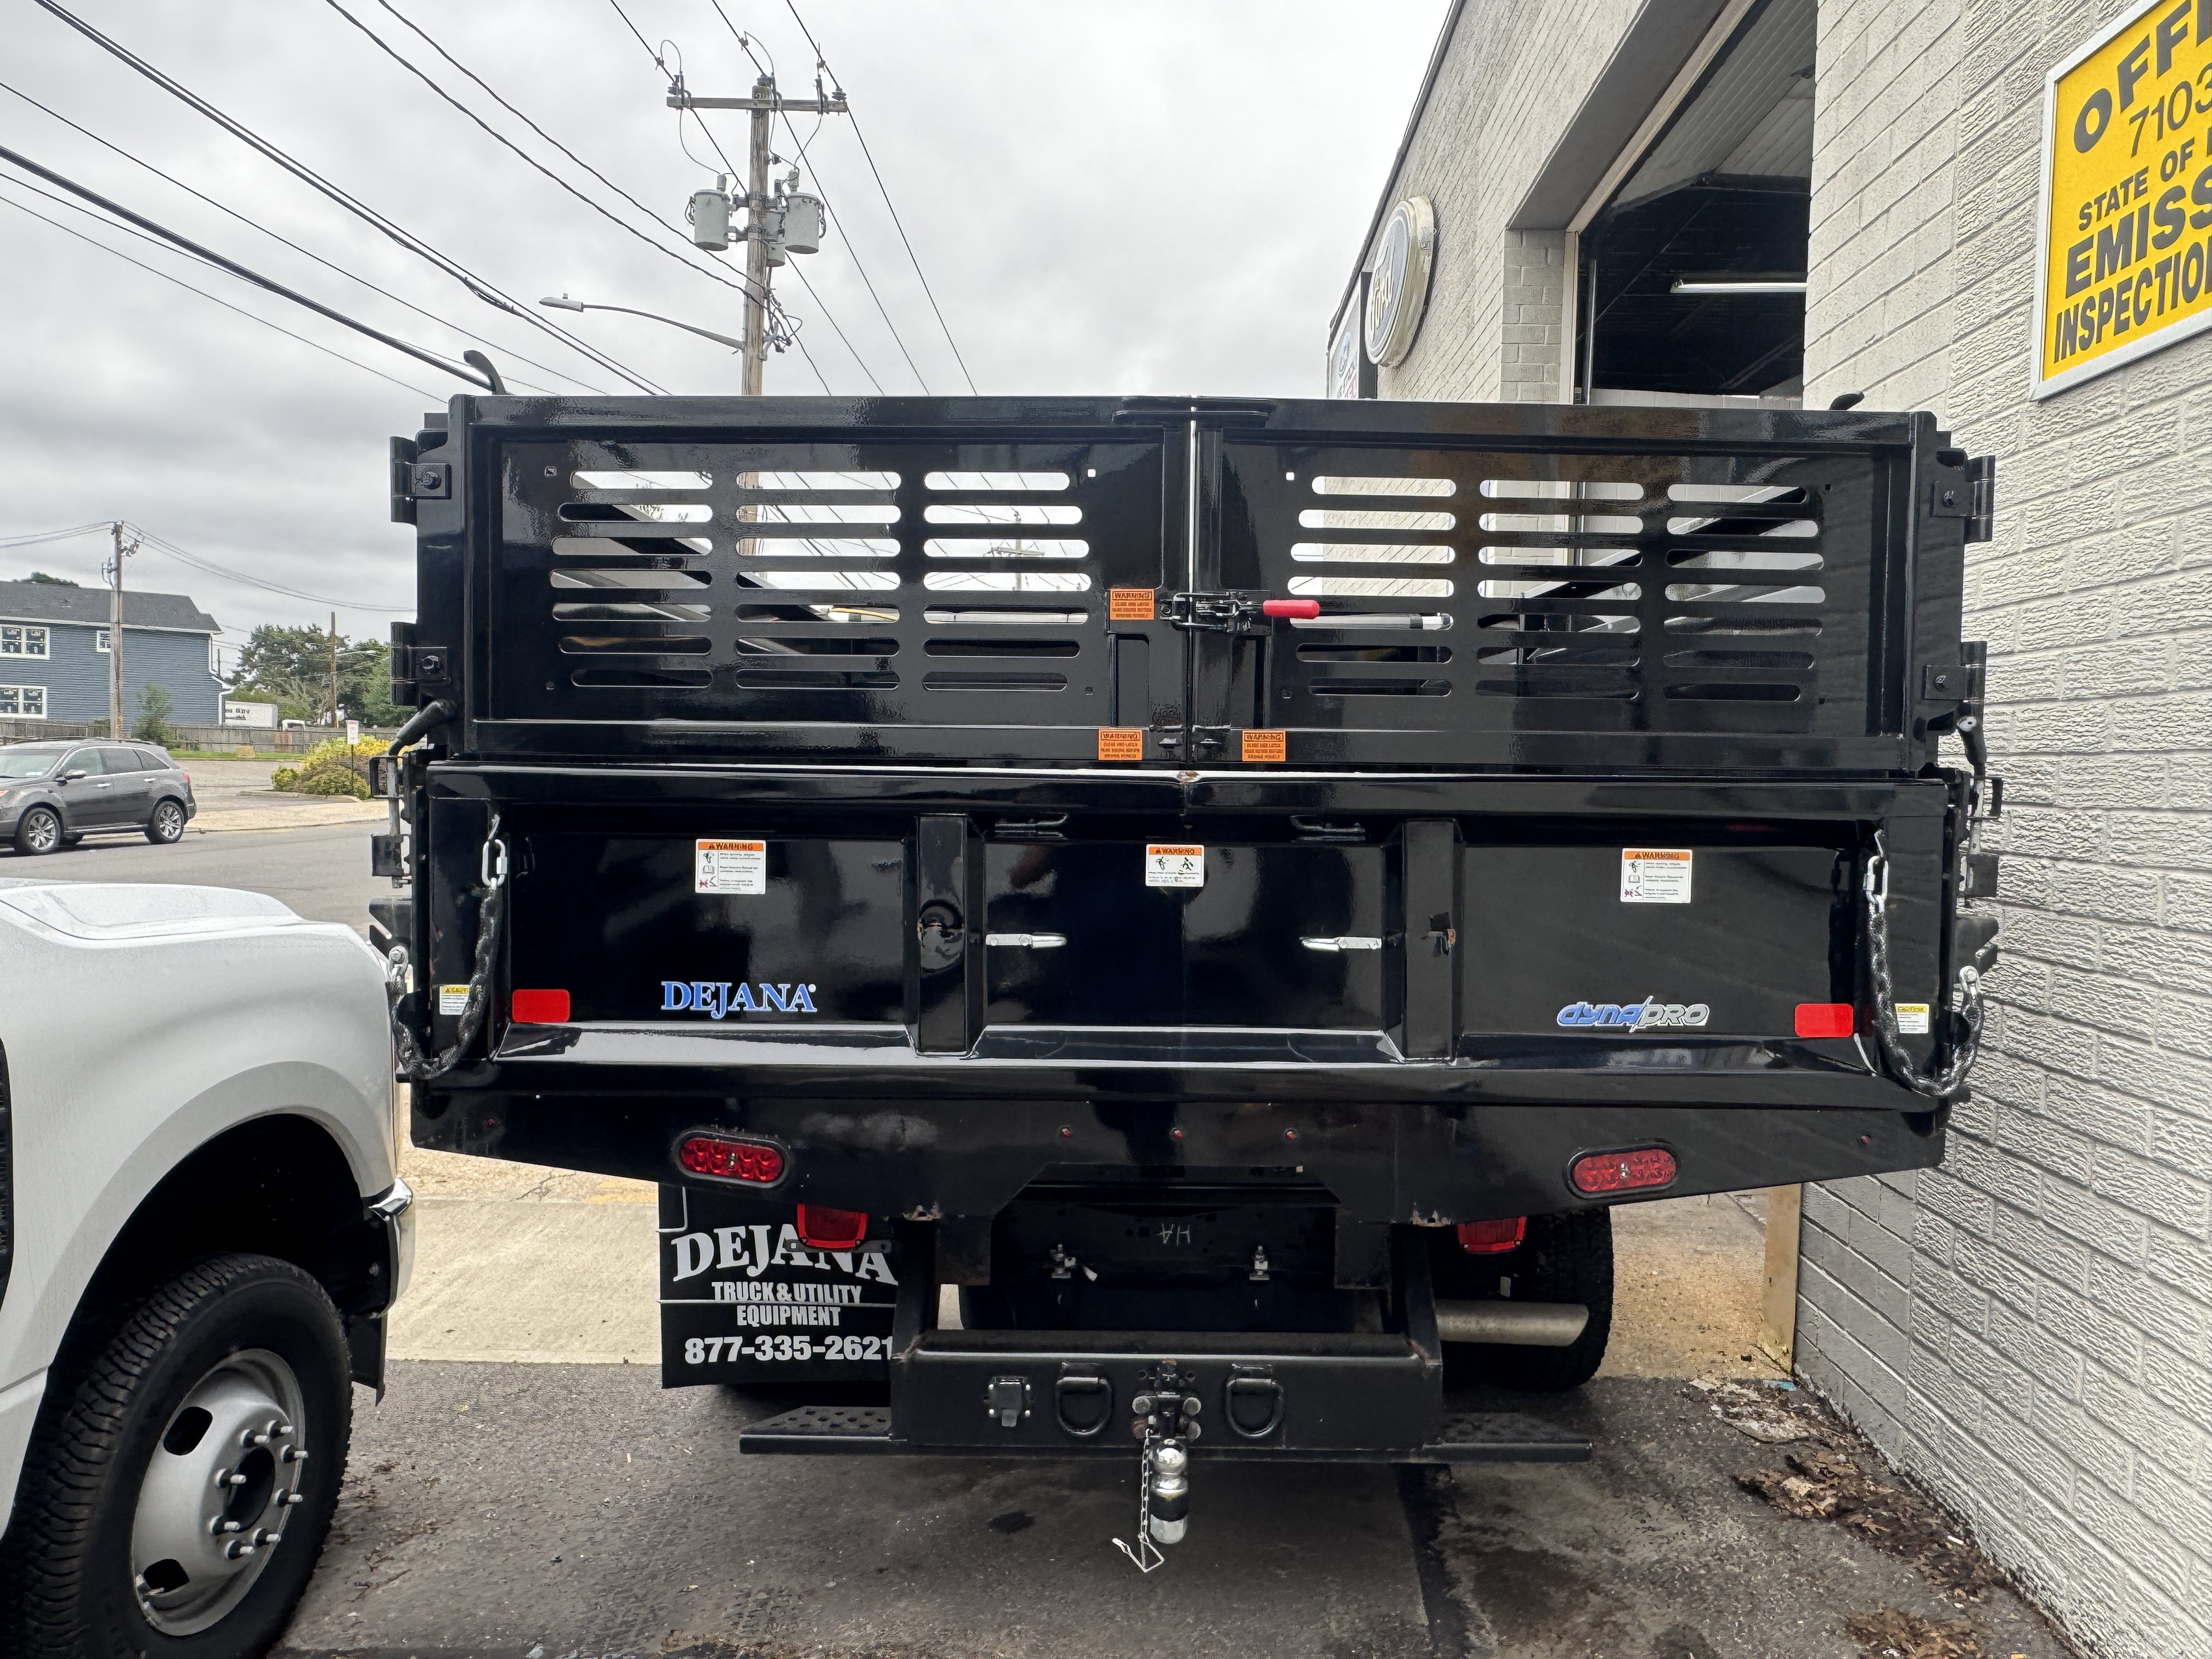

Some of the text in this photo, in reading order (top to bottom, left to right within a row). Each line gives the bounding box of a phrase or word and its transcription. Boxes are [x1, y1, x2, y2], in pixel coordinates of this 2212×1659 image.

[2079, 166, 2148, 231] STATE
[2160, 137, 2194, 182] OF
[661, 981, 818, 1019] DEJANA
[737, 1305, 841, 1327] EQUIPMENT
[685, 1335, 893, 1364] 877-335-2621
